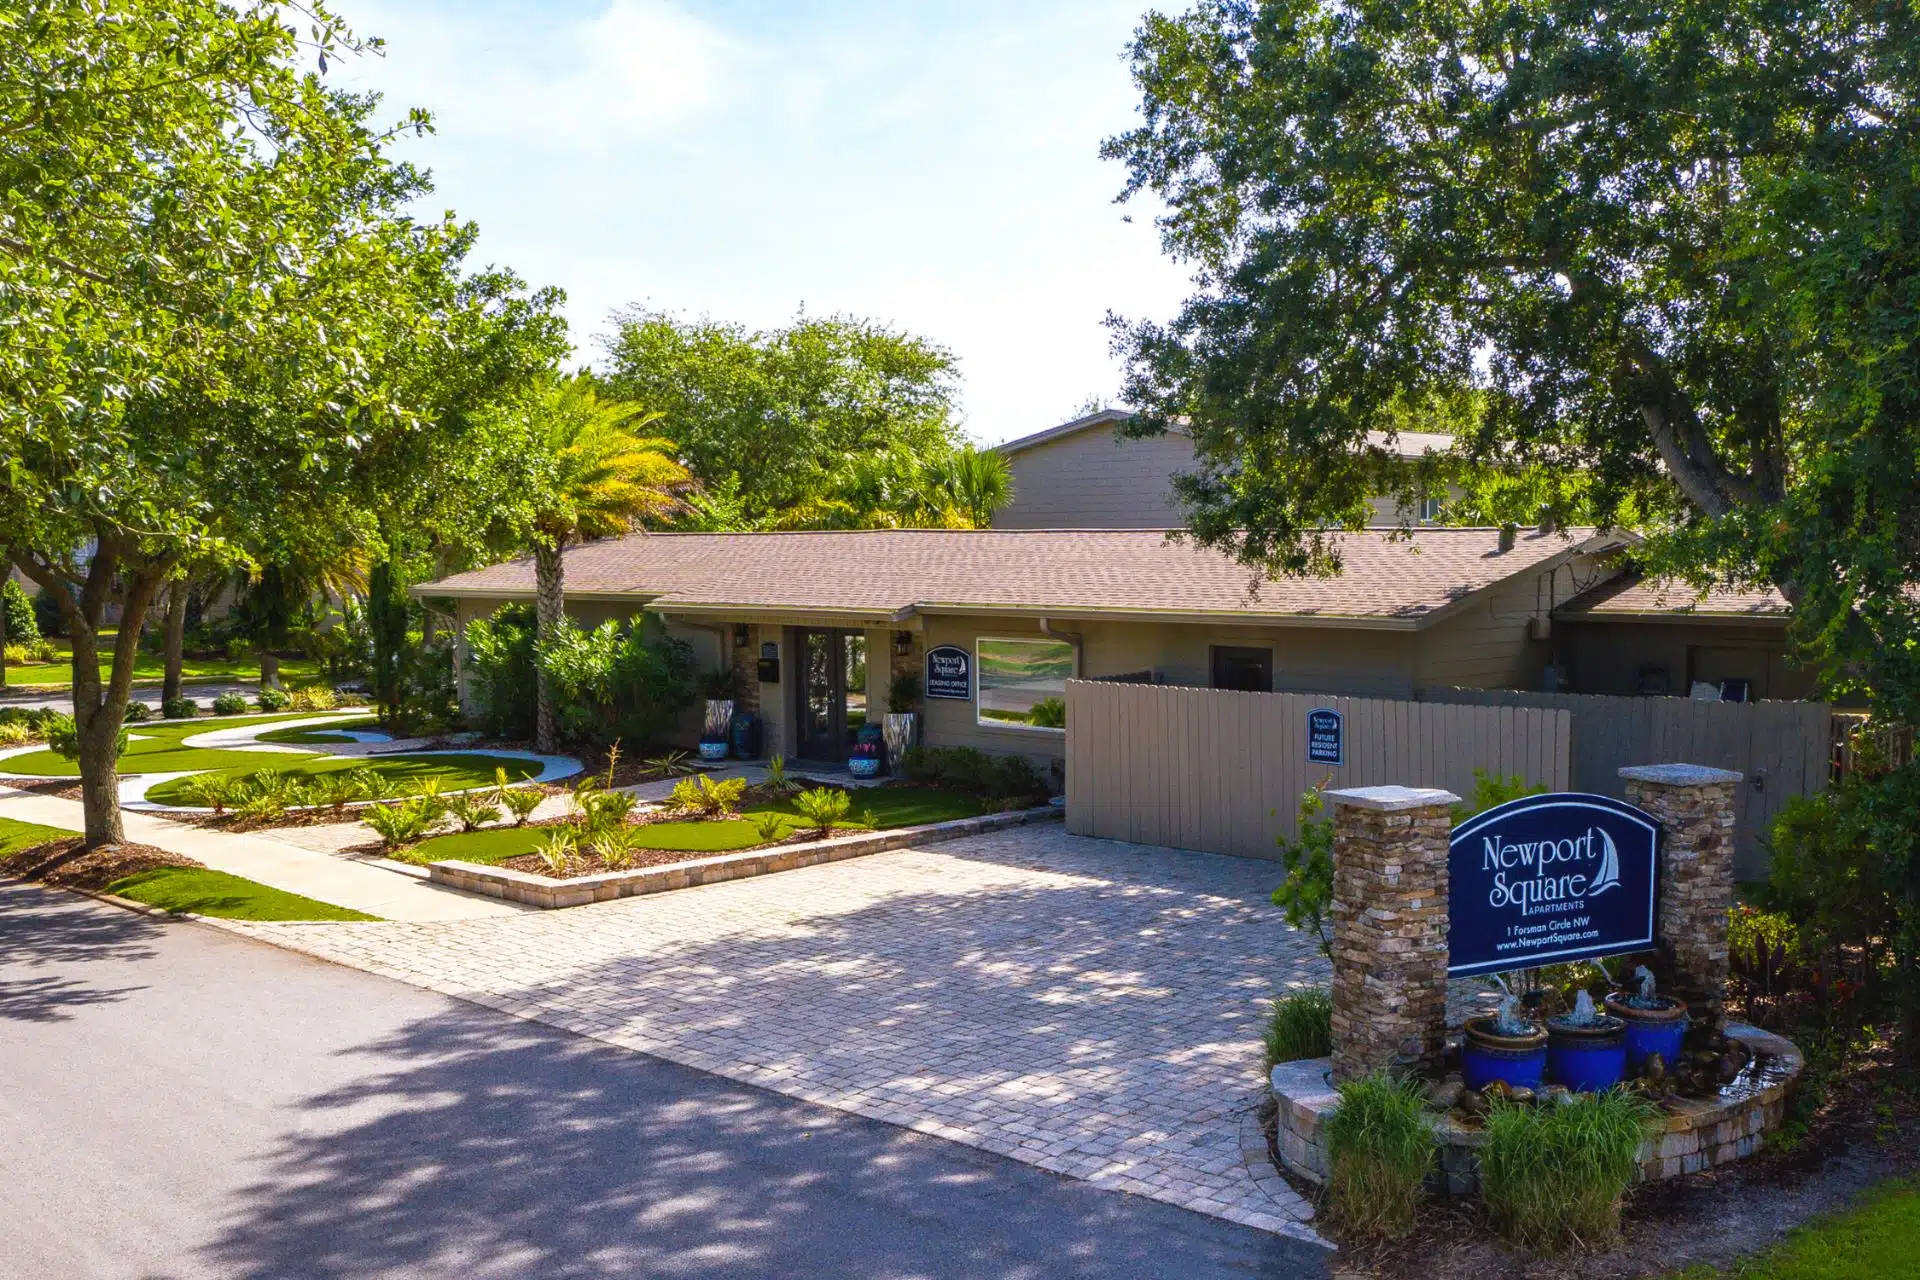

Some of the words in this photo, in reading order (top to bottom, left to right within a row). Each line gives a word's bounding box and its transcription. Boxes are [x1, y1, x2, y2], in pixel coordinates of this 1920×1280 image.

[929, 679, 951, 687] LEASING
[1311, 741, 1338, 750] RESIDENT
[1314, 734, 1335, 742] FUTURE
[1311, 749, 1337, 757] PARKING
[1482, 827, 1597, 877] Newport
[1489, 871, 1587, 916] Square
[1528, 900, 1585, 915] APARTMENTS
[1507, 926, 1512, 937] 1
[1513, 923, 1547, 937] Forsman
[1548, 918, 1571, 931] Circle
[1573, 915, 1591, 928] NW
[1496, 929, 1599, 951] www.NewportSquare.com
